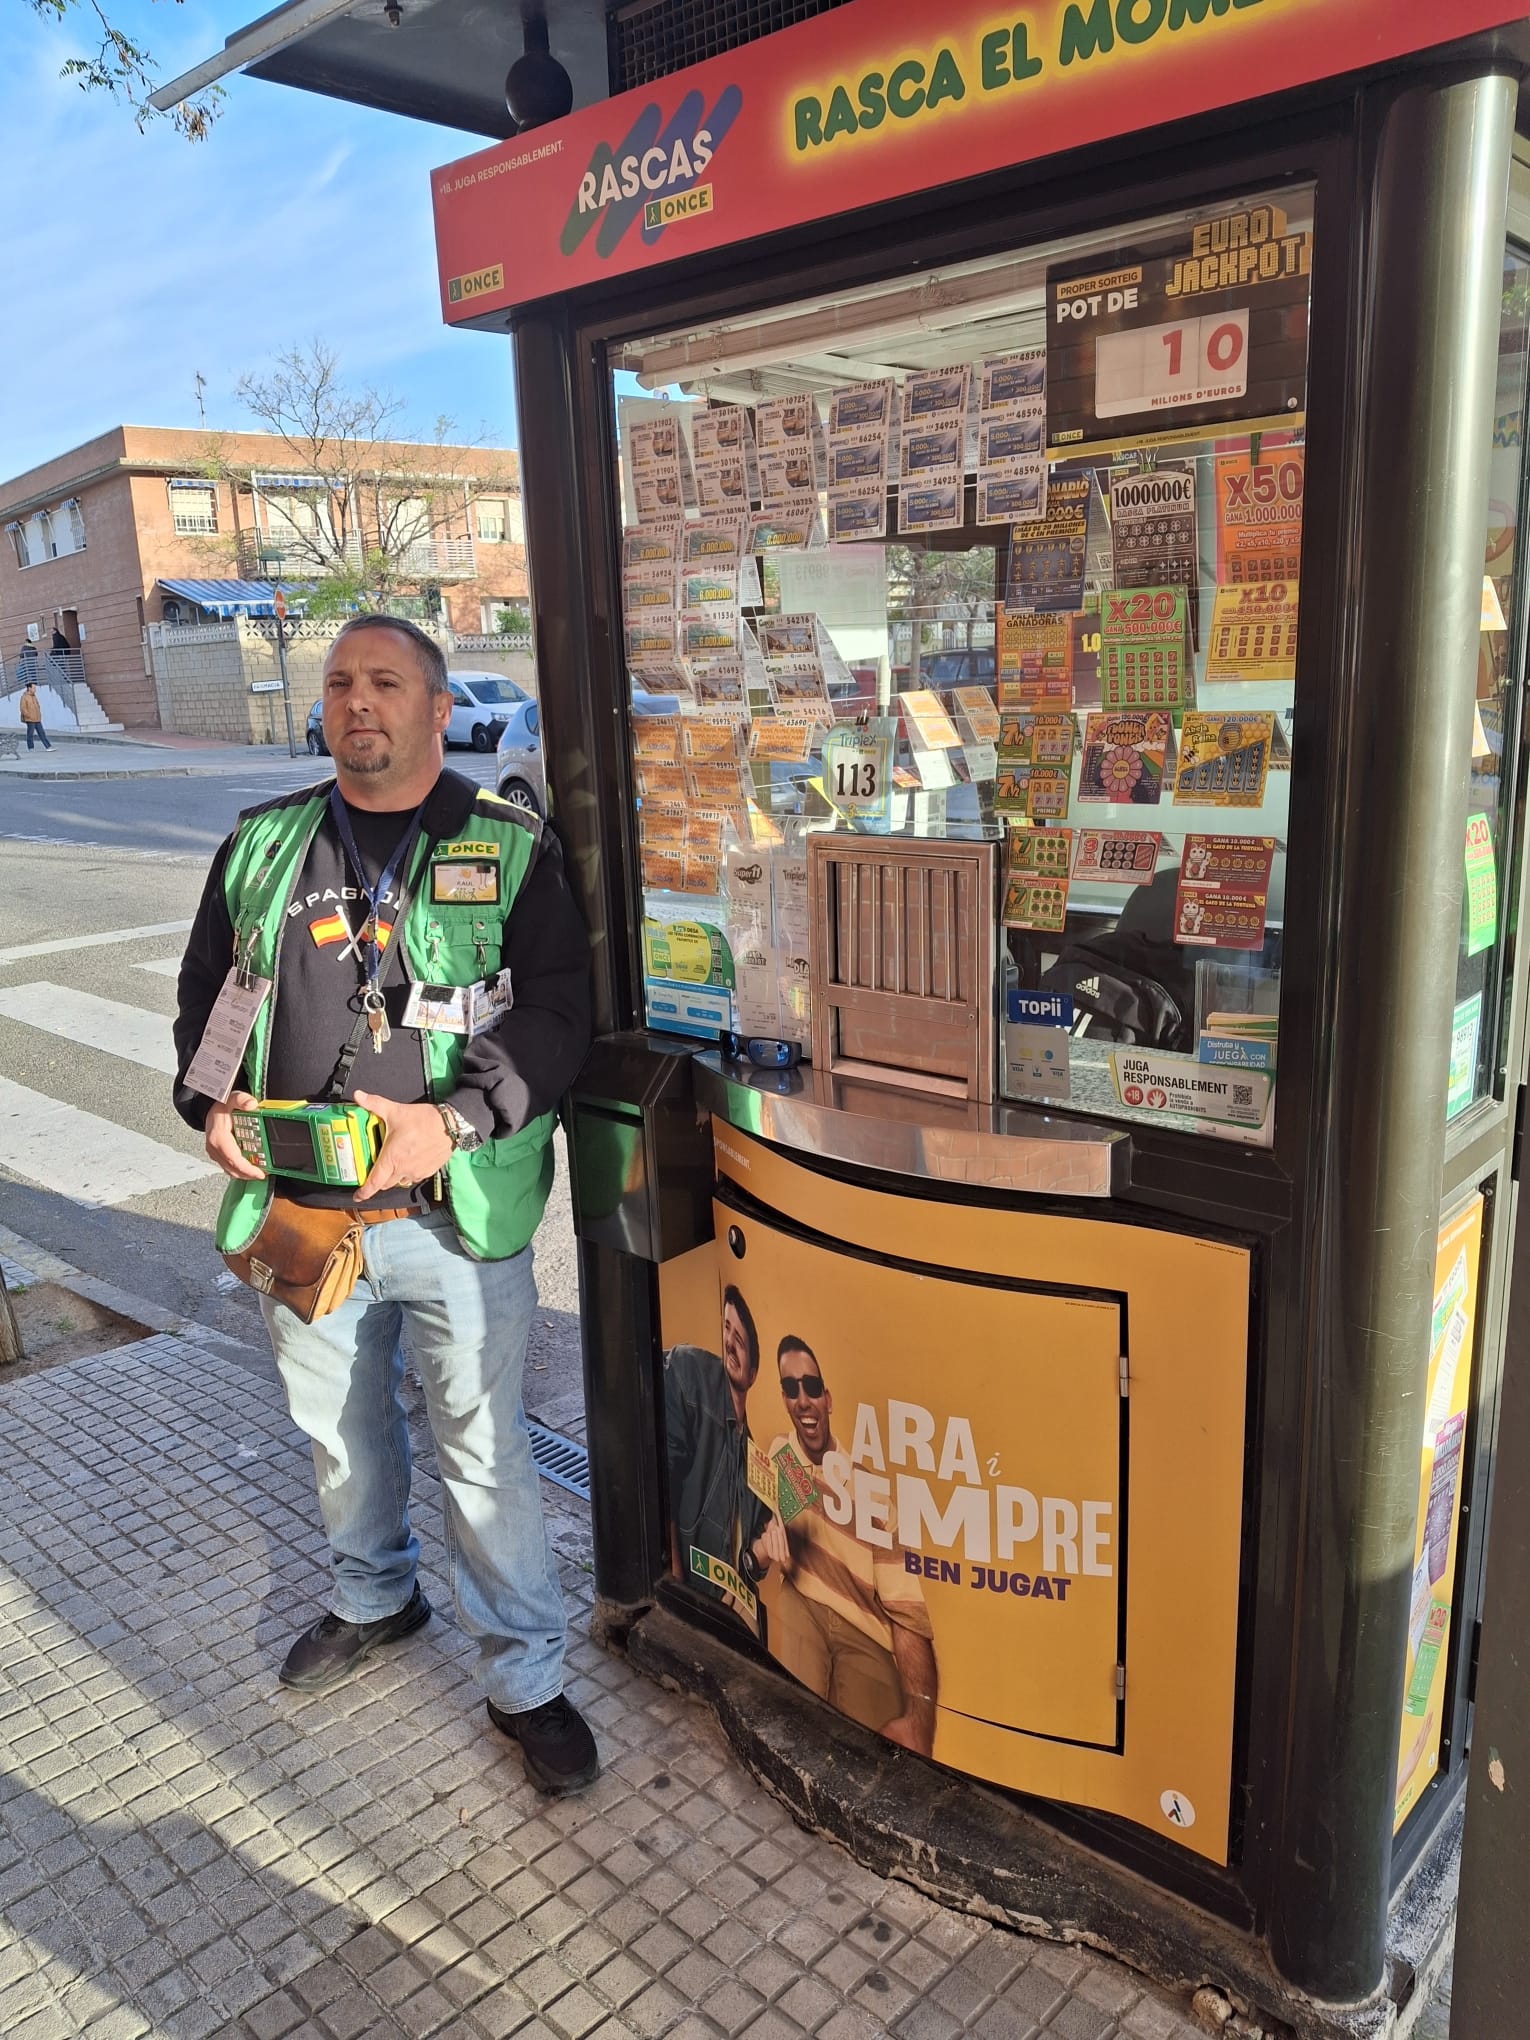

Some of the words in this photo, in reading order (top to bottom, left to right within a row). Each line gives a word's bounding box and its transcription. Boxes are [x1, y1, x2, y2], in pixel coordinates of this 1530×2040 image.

[794, 48, 966, 151] RASCA
[981, 22, 1043, 91] EL
[454, 174, 477, 192] JUGA
[477, 140, 565, 182] RESPONSABLEMENT.
[577, 130, 714, 214] RASCAS
[664, 189, 709, 218] ONCE
[1193, 208, 1270, 257] EURO
[1165, 236, 1301, 297] JACKPOT
[463, 269, 501, 295] ONCE
[1060, 281, 1097, 297] PROPER
[1098, 271, 1139, 288] SORTEIG
[1056, 296, 1102, 324] POT
[1108, 288, 1139, 313] DE
[1019, 350, 1046, 361] 48596
[939, 365, 964, 377] 34925
[785, 394, 806, 405] 10725
[1151, 391, 1193, 406] MILIONS
[1196, 385, 1242, 399] D'EUROS
[1016, 407, 1043, 419] 48596
[934, 419, 959, 431] 34925
[1061, 431, 1082, 441] ONCE
[787, 446, 808, 457] 10725
[1013, 464, 1040, 476] 48596
[932, 475, 957, 486] 34925
[786, 615, 810, 625] 54216
[1006, 617, 1064, 628] GANADORAS
[793, 663, 817, 672] 54216
[803, 708, 827, 716] 54216
[836, 763, 876, 797] 113
[451, 844, 495, 854] ONCE
[1075, 983, 1101, 999] adidas
[1207, 1040, 1234, 1049] Disfruta
[1123, 1059, 1150, 1073] JUGA
[1123, 1071, 1229, 1095] RESPONSABLEMENT
[1127, 1089, 1140, 1101] +18
[849, 1398, 982, 1485] ARA
[986, 1451, 1002, 1478] i
[821, 1450, 1114, 1578] SEMPRE
[903, 1549, 961, 1585] BEN
[970, 1567, 1072, 1602] JUGAT
[712, 1561, 755, 1611] ONCE
